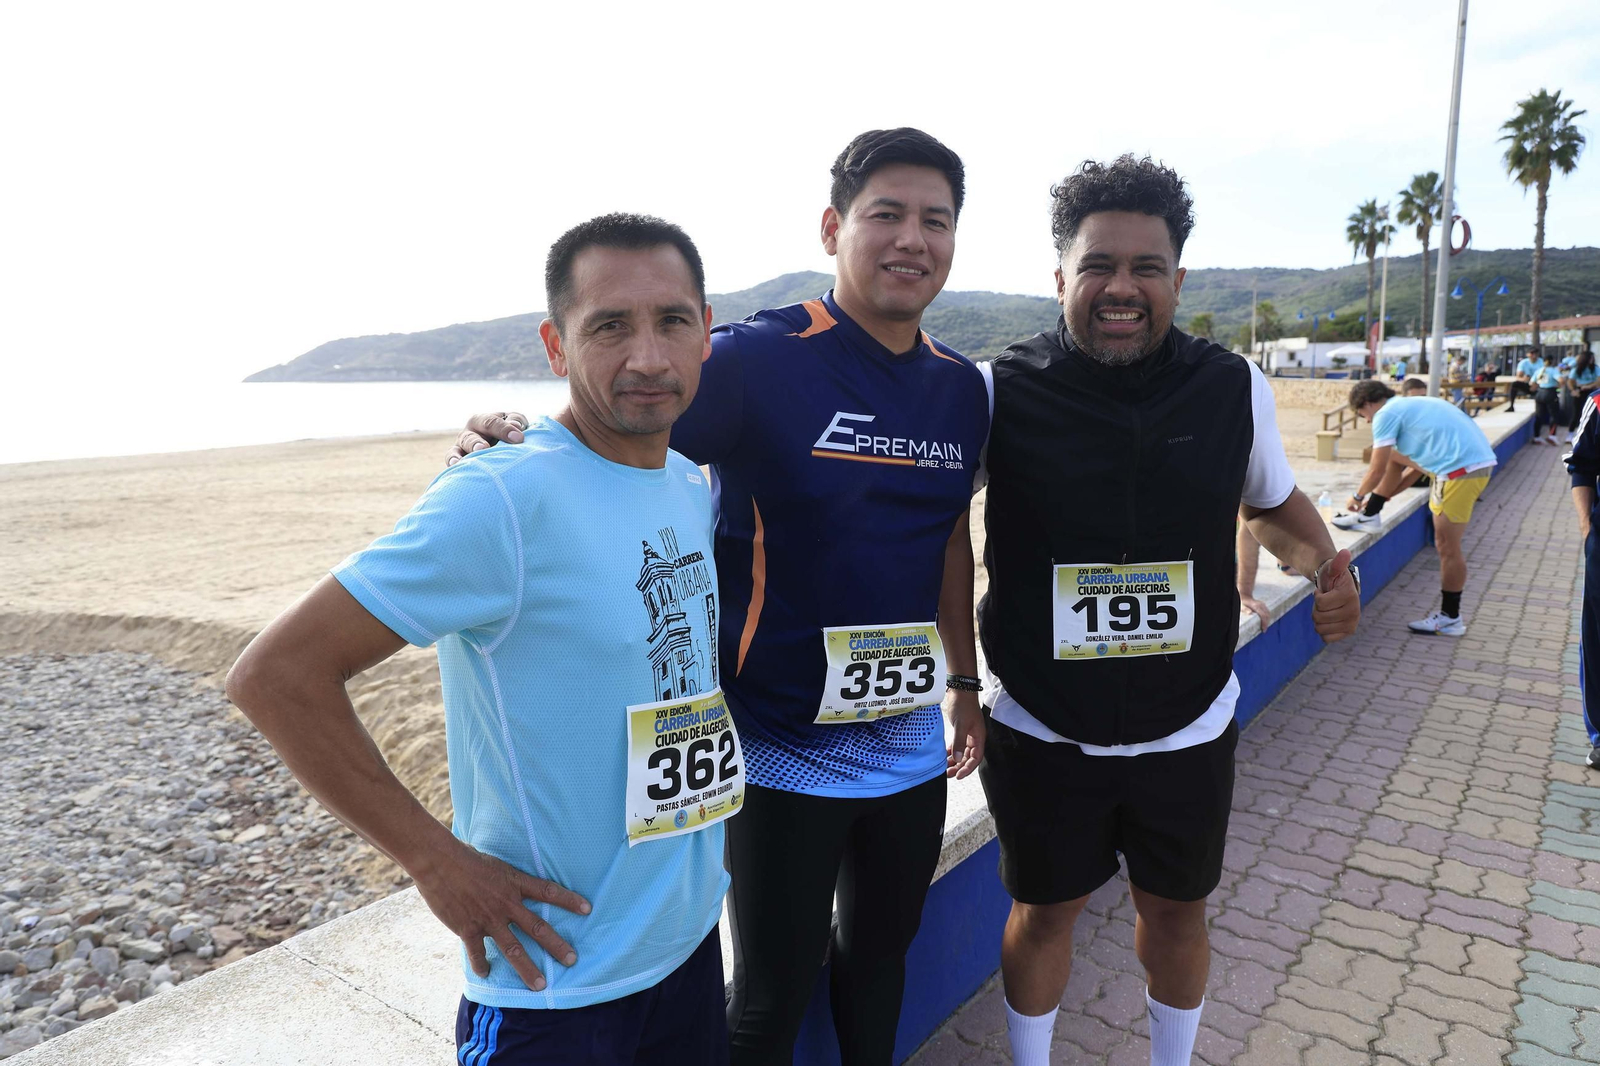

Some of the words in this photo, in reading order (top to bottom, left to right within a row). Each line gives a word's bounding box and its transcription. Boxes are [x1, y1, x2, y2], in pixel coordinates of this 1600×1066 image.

[813, 411, 963, 461] EPREMAIN
[916, 459, 939, 468] JEREZ
[945, 461, 963, 469] CEUTA
[674, 551, 704, 569] CARRERA
[1091, 566, 1113, 574] EDICIÓN
[675, 563, 713, 600] URBANA
[1077, 574, 1125, 585] CARRERA
[1125, 572, 1169, 584] URBANA
[1078, 584, 1111, 596] CIUDAD
[1112, 585, 1123, 594] DE
[1125, 583, 1170, 594] ALGECIRAS
[1071, 594, 1178, 632] 195
[849, 637, 894, 650] CARRERA
[896, 634, 929, 647] URBANA
[863, 630, 886, 638] EDICIÓN
[1086, 634, 1111, 642] GONZÁLEZ
[1112, 634, 1126, 642] VERA,
[851, 650, 881, 661] CIUDAD
[882, 649, 893, 659] DE
[893, 645, 931, 658] ALGECIRAS
[840, 656, 935, 700] 353
[889, 697, 900, 705] JOSÉ
[654, 711, 700, 733] CARRERA
[701, 703, 726, 723] URBANA
[656, 709, 668, 719] XXV
[669, 704, 692, 717] EDICIÓN
[655, 731, 689, 748] CIUDAD
[690, 727, 700, 740] DE
[701, 717, 730, 738] ALGECIRAS
[647, 730, 738, 800] 362
[656, 801, 680, 813] PASTAS
[702, 789, 717, 800] EDWIN
[717, 782, 733, 796] EDUARDO
